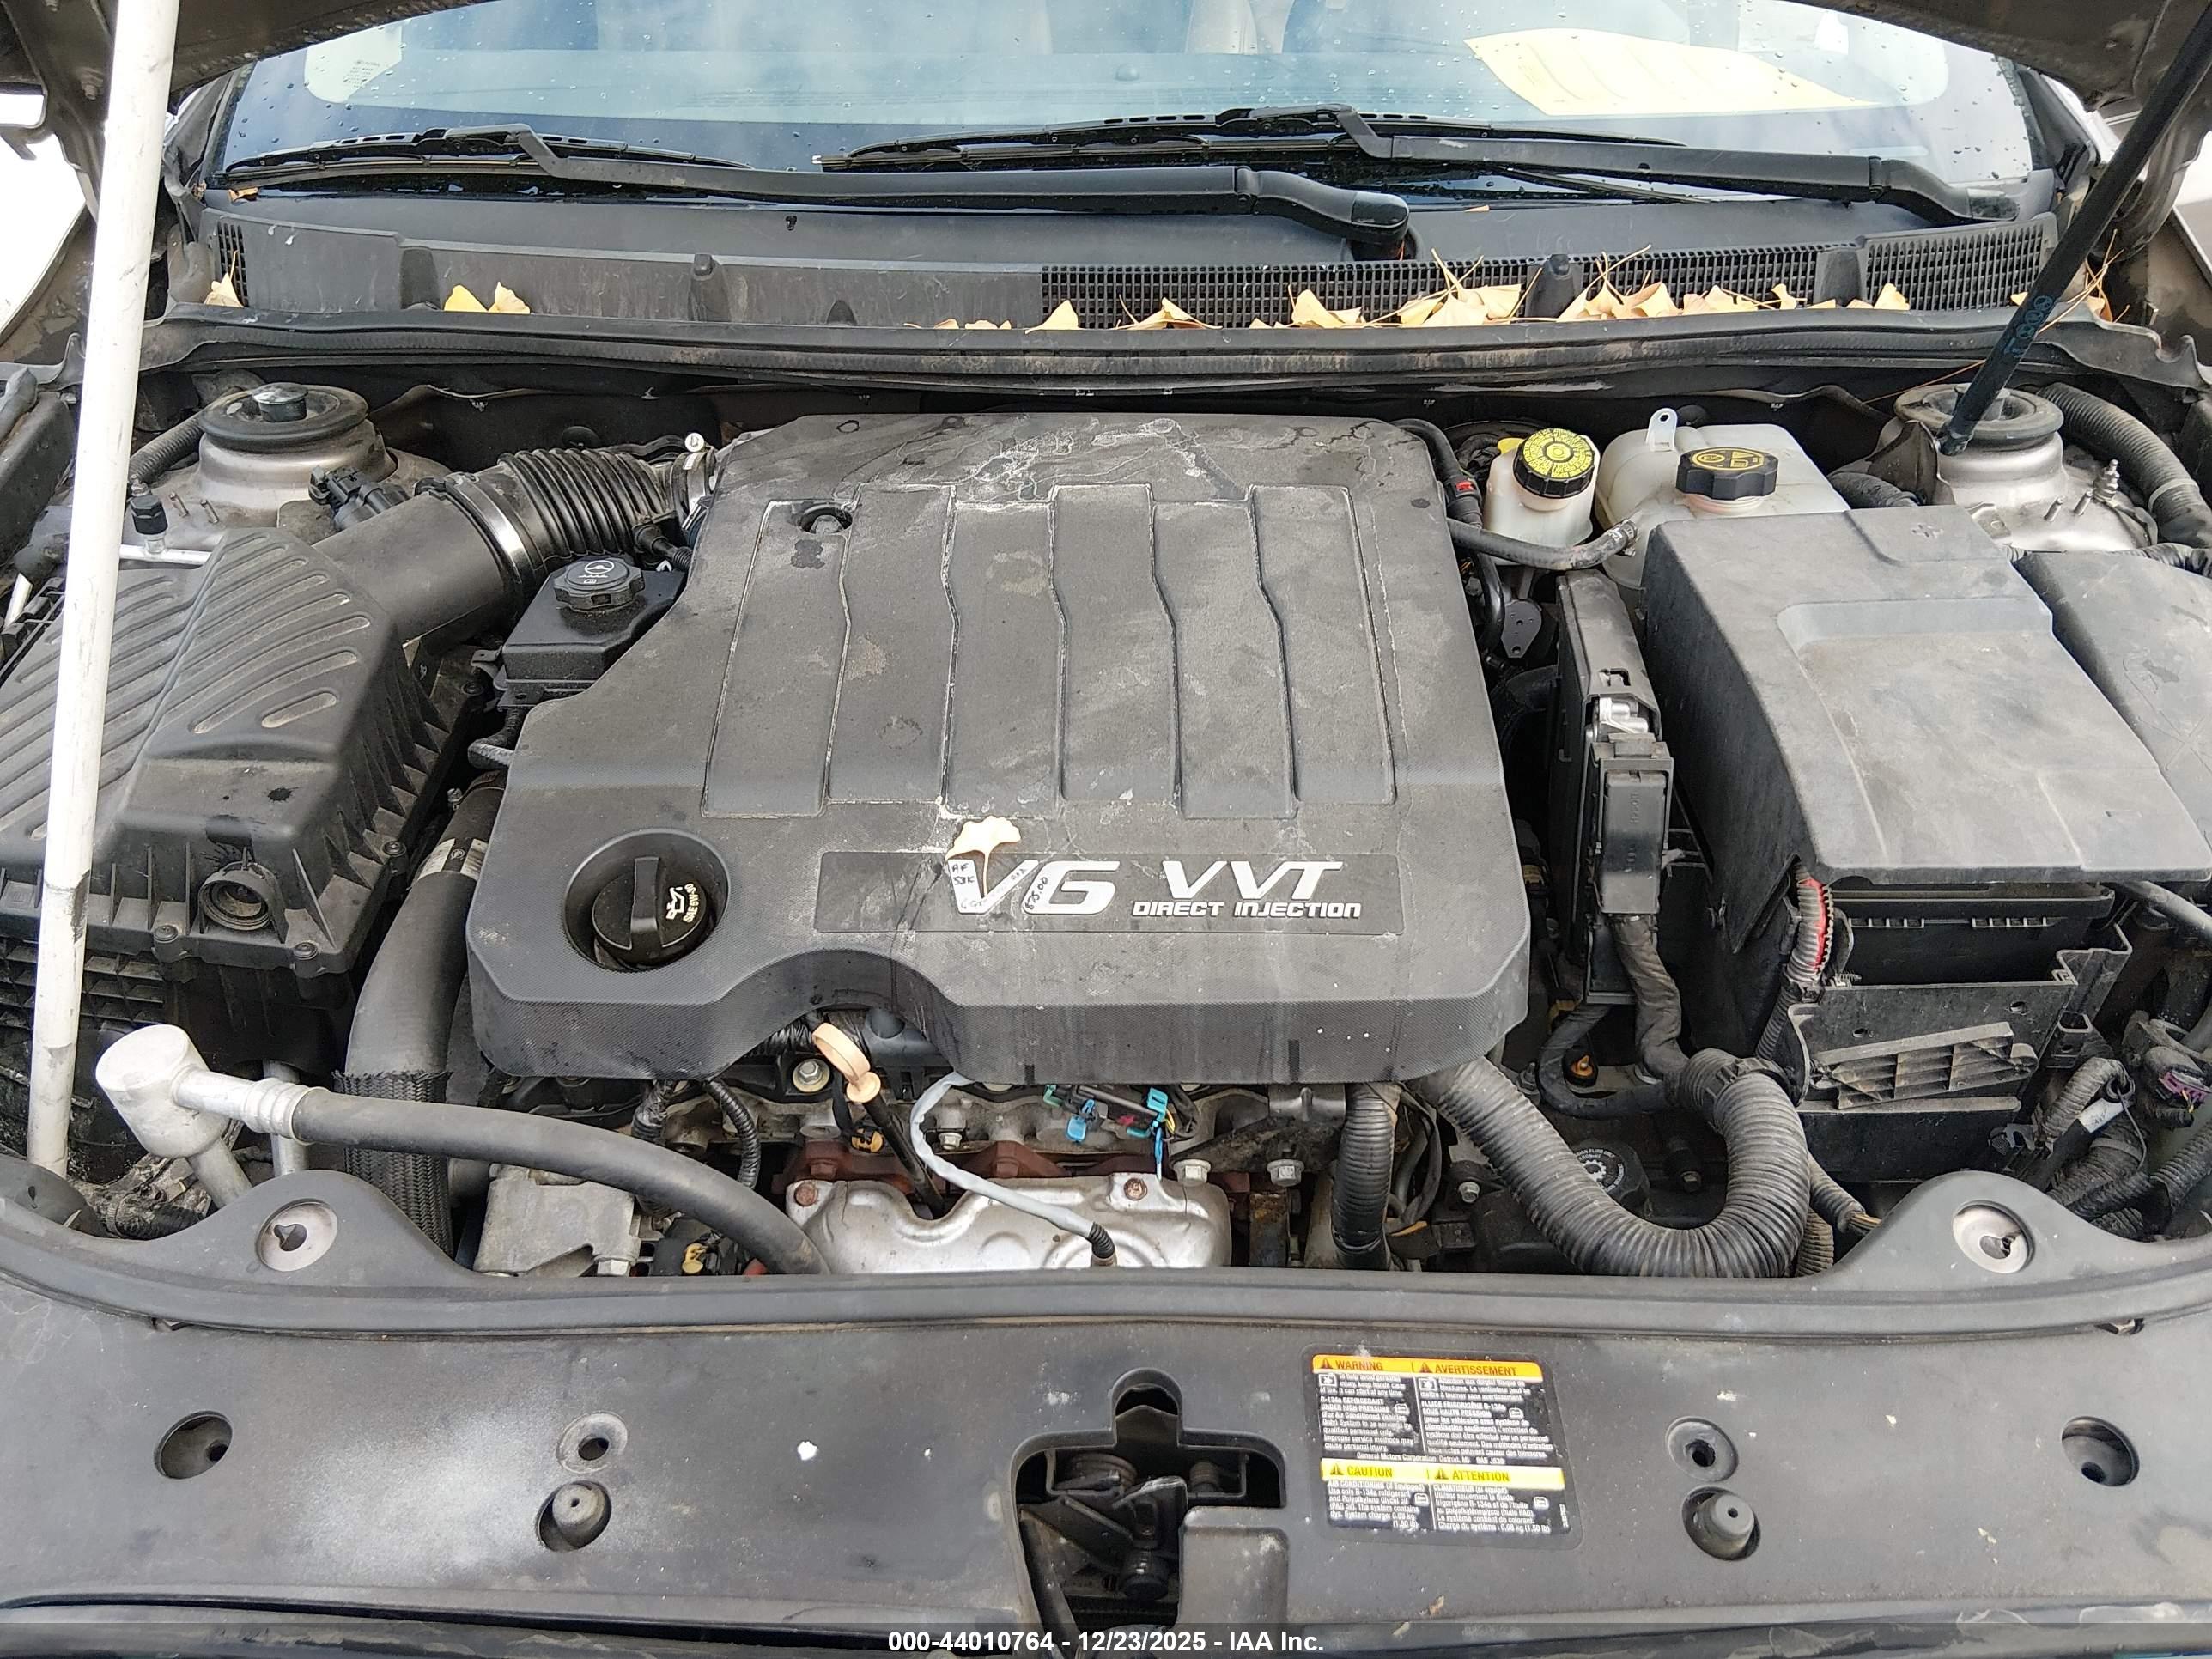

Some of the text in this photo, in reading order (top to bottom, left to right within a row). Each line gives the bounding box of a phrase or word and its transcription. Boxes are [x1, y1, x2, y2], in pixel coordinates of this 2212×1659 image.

[948, 860, 1343, 915] V6 VVT
[684, 907, 698, 923] SAE
[1132, 901, 1362, 919] DIRECT INJECTION
[1335, 1360, 1383, 1370] WARNING
[1435, 1364, 1516, 1376] AVERTISSEMENT
[1347, 1466, 1393, 1477] CAUTION
[1452, 1472, 1510, 1481] ATTENTION
